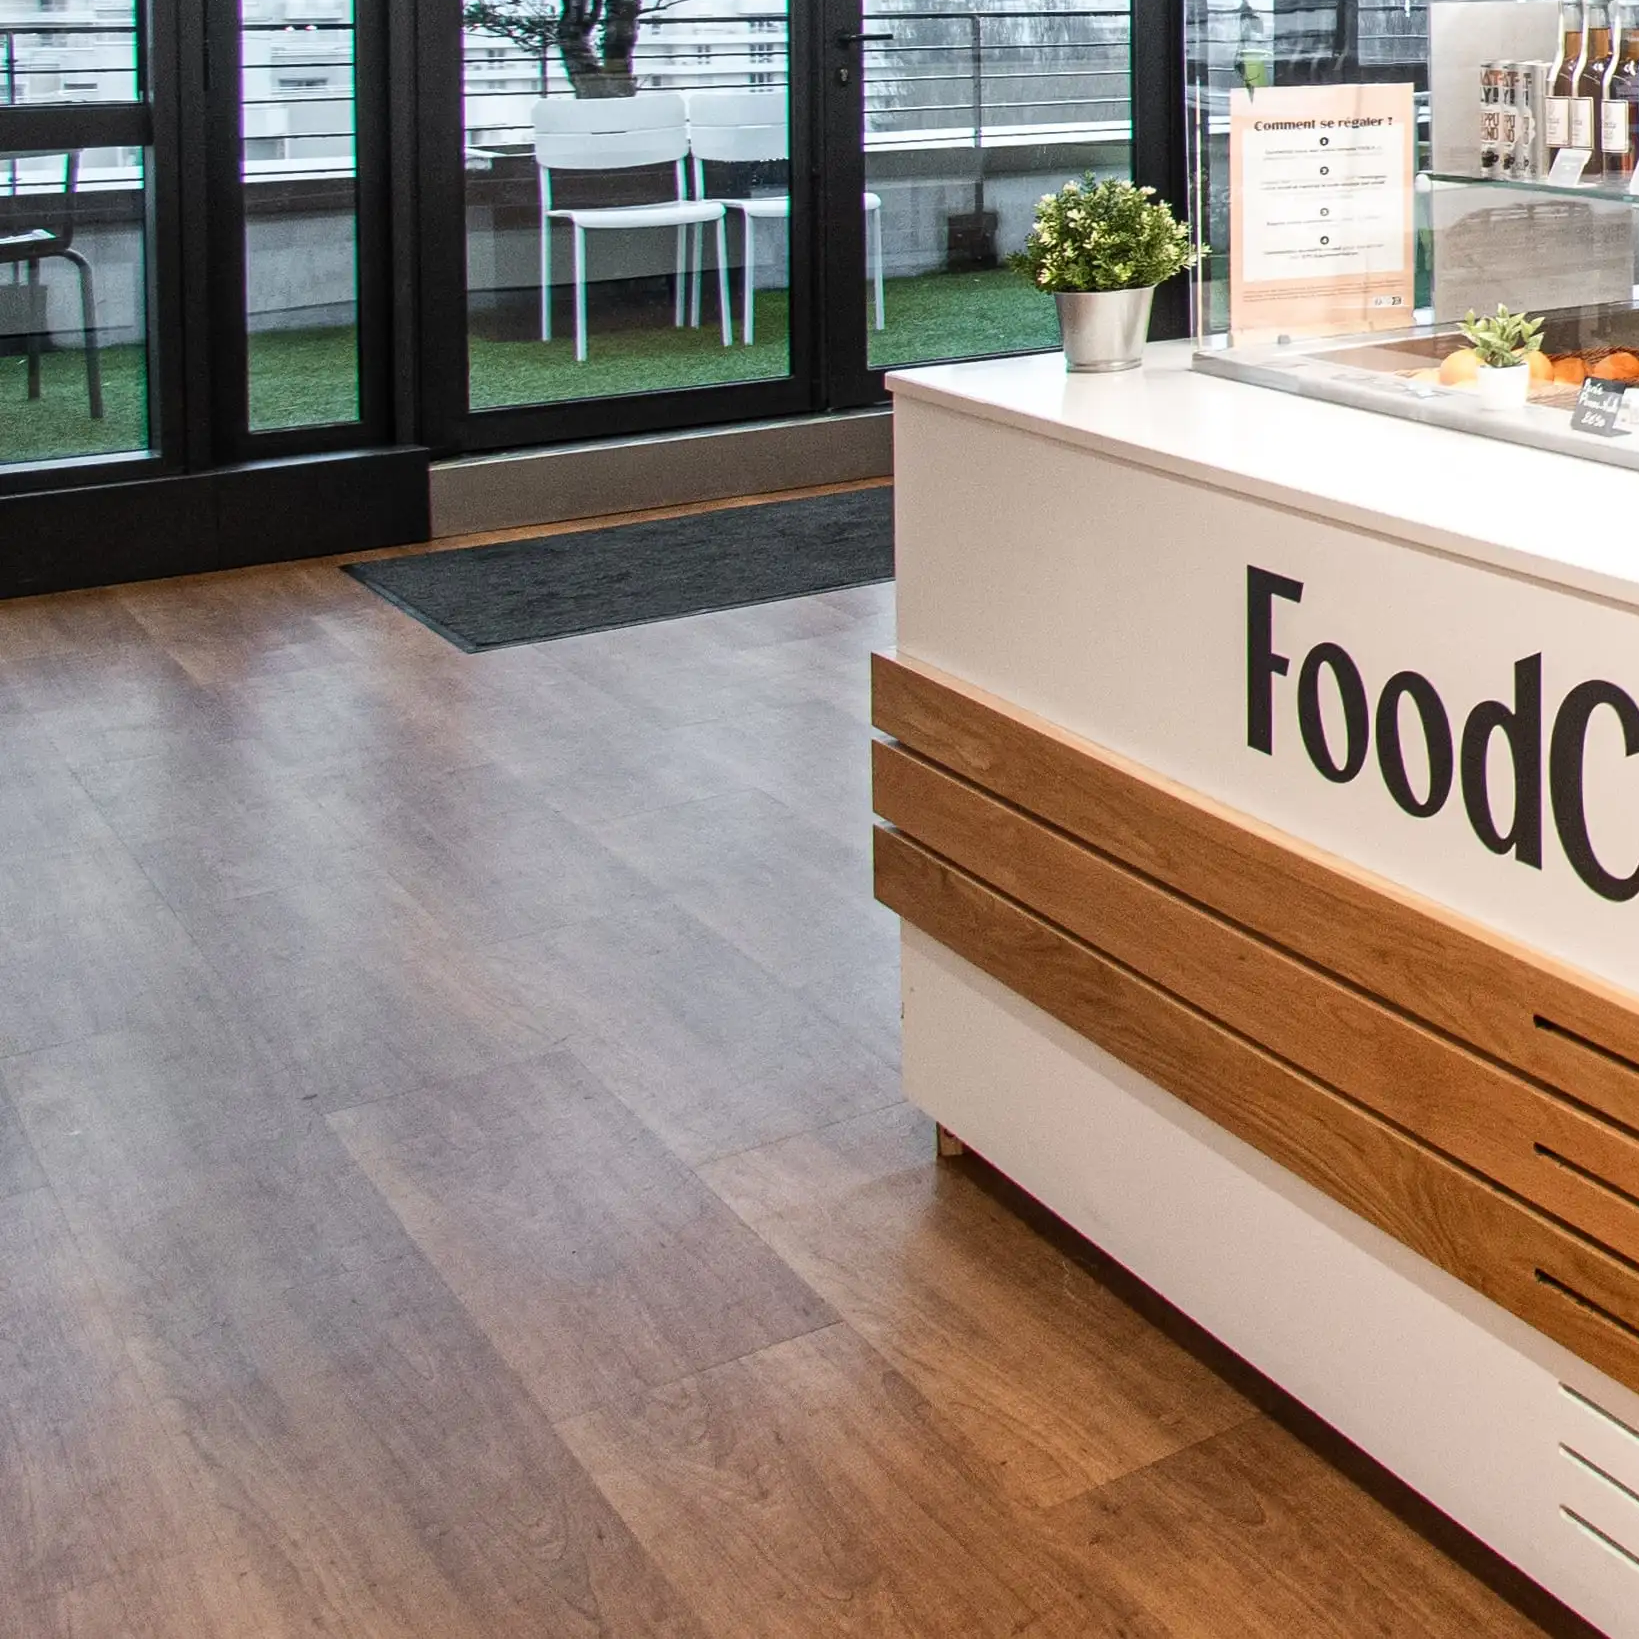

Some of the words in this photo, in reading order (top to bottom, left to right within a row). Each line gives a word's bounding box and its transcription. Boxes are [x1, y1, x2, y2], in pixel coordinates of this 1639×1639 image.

[1254, 119, 1316, 132] Comment
[1320, 119, 1335, 129] se
[1338, 116, 1384, 129] régaler
